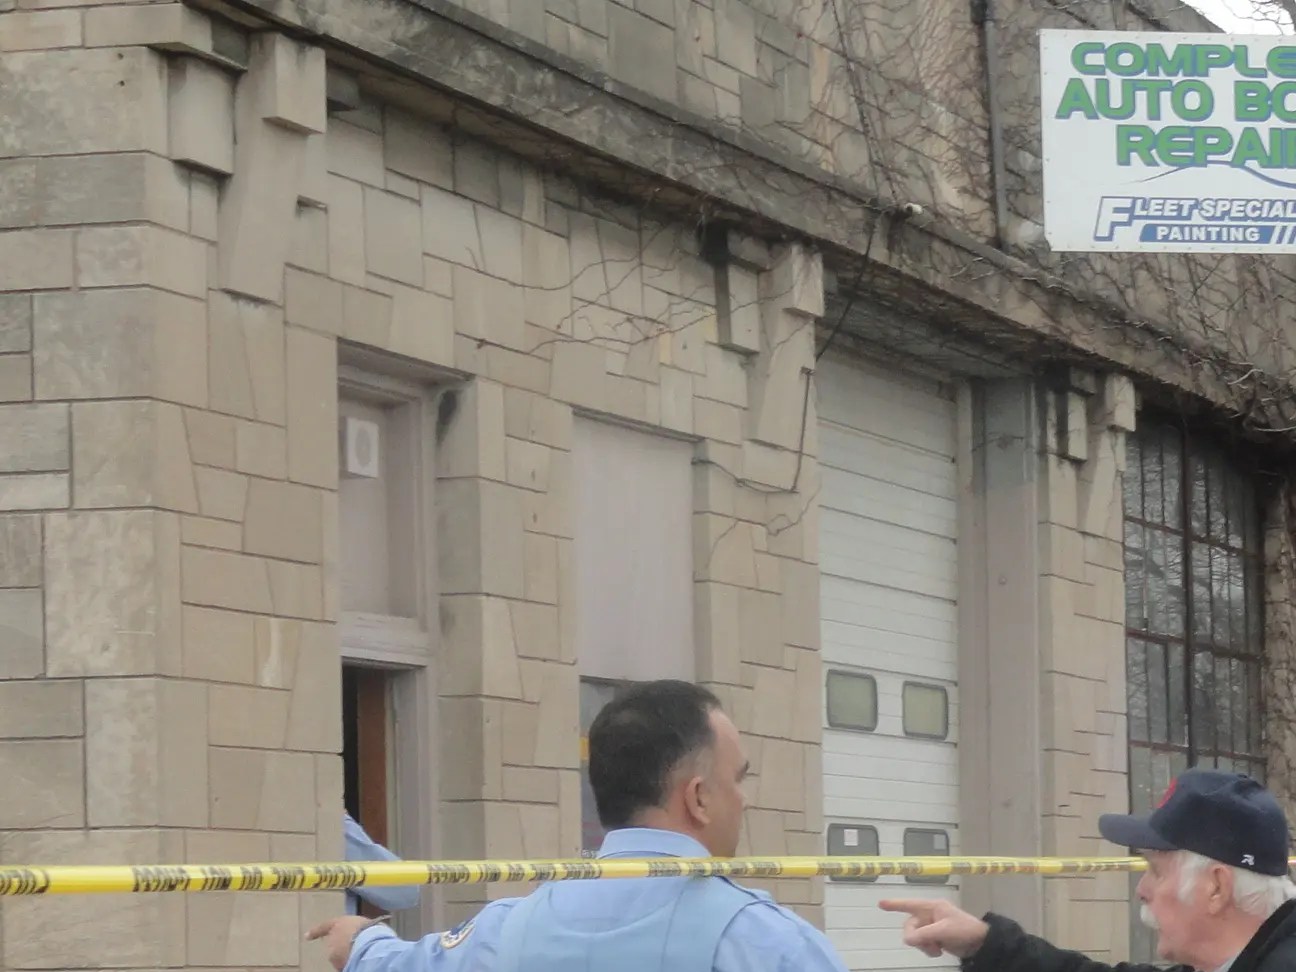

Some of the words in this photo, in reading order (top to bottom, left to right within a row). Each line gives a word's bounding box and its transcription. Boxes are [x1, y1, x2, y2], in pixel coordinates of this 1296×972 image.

[1055, 78, 1215, 121] AUTO
[1094, 196, 1198, 241] FLEET
[1156, 226, 1261, 242] PAINTING
